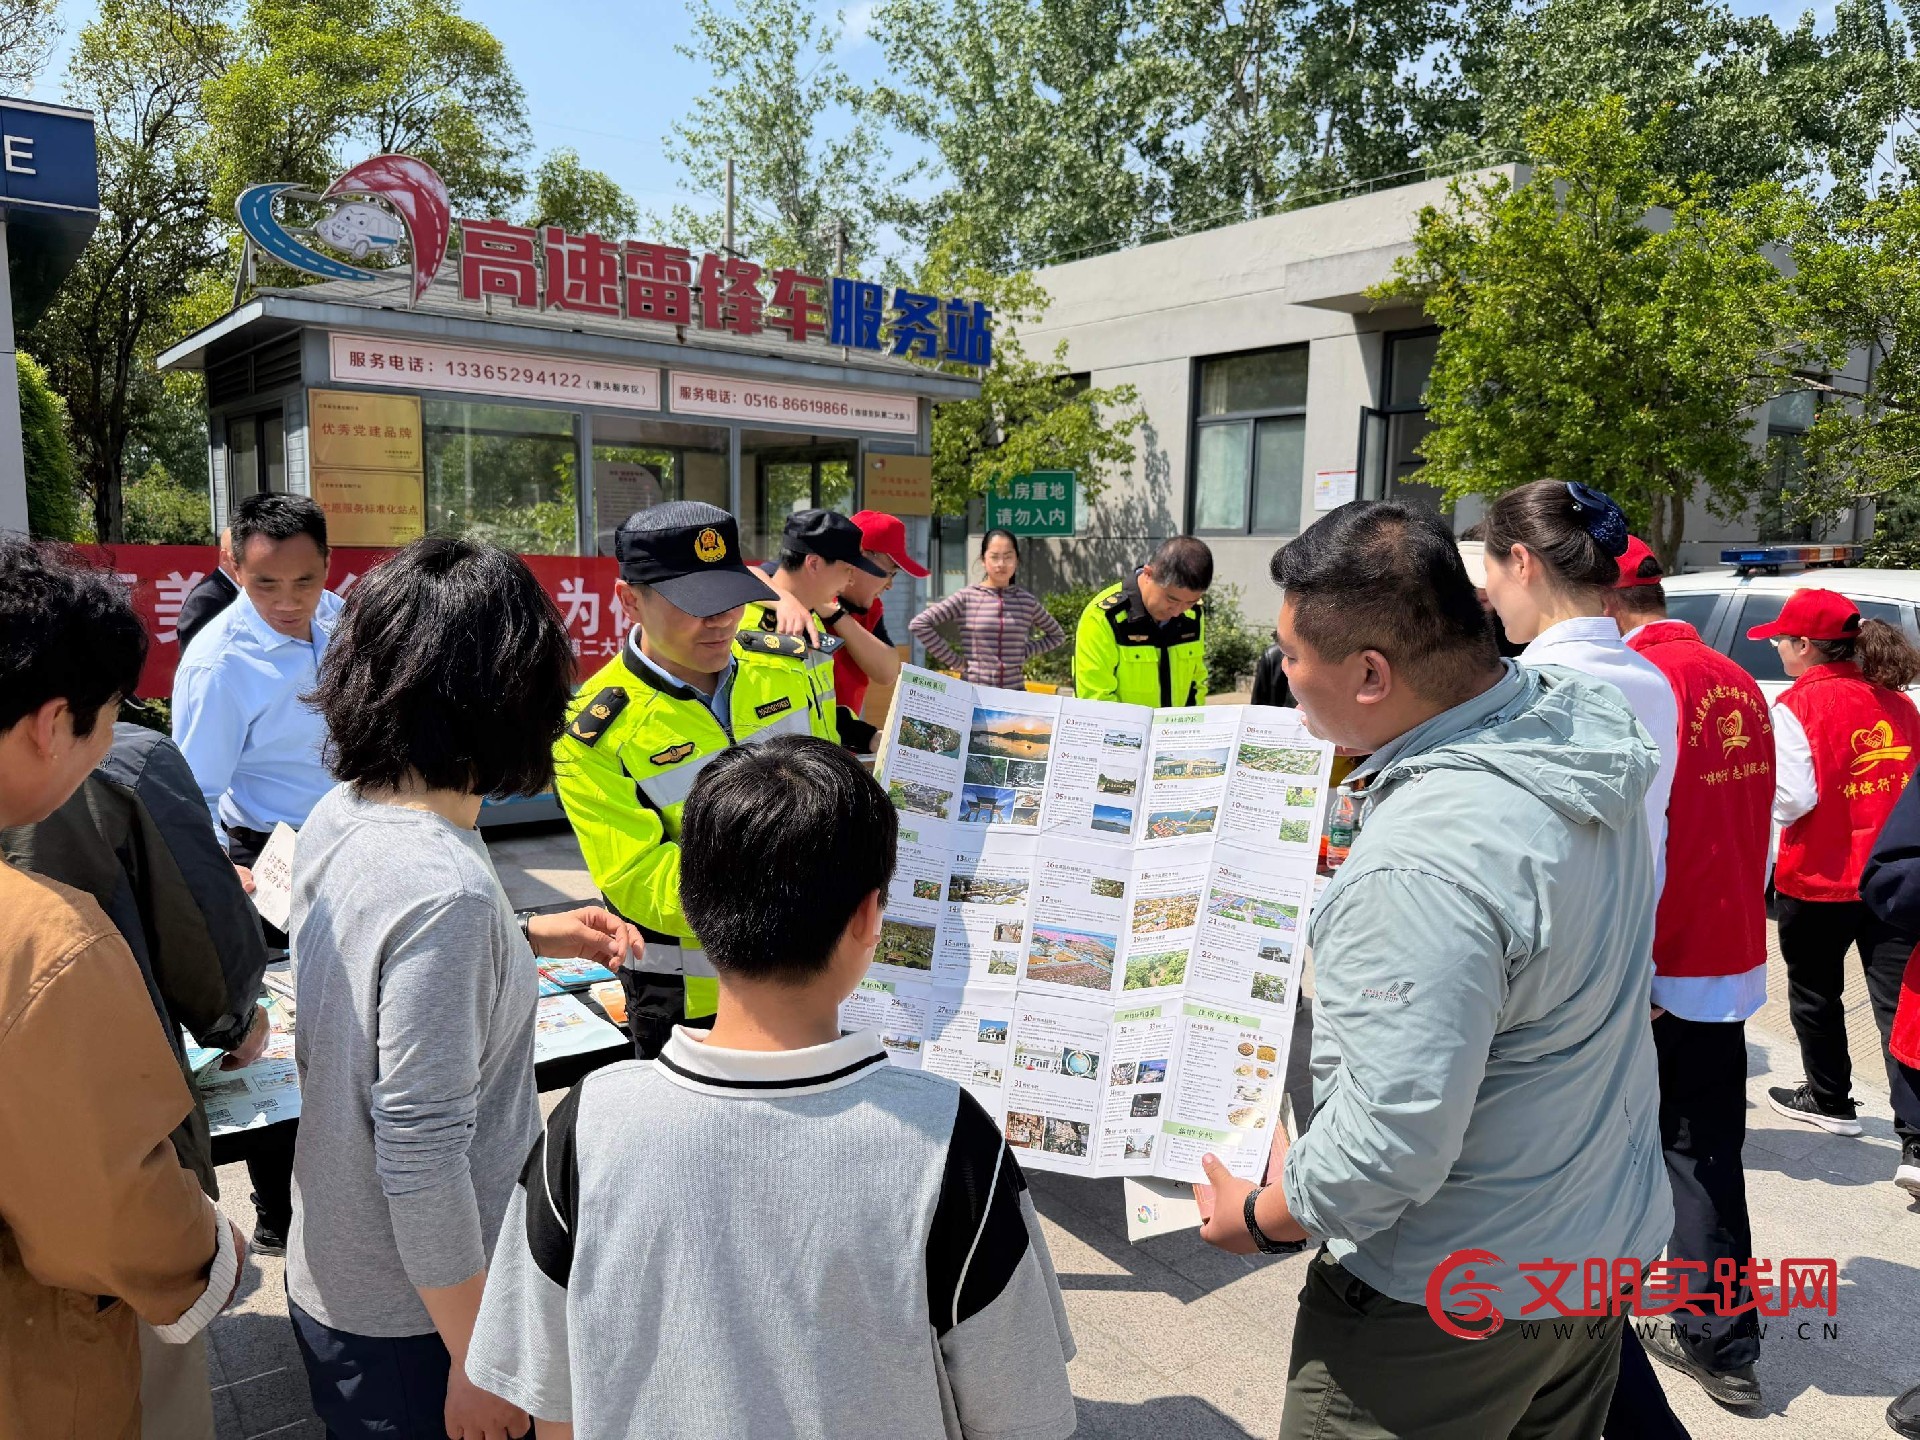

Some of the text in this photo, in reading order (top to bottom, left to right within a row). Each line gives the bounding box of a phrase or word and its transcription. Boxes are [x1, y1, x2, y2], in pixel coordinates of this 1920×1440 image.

[460, 218, 992, 367] 高速雷锋车服务站
[322, 423, 412, 439] 优秀党建品牌
[996, 508, 1066, 526] 请勿入内
